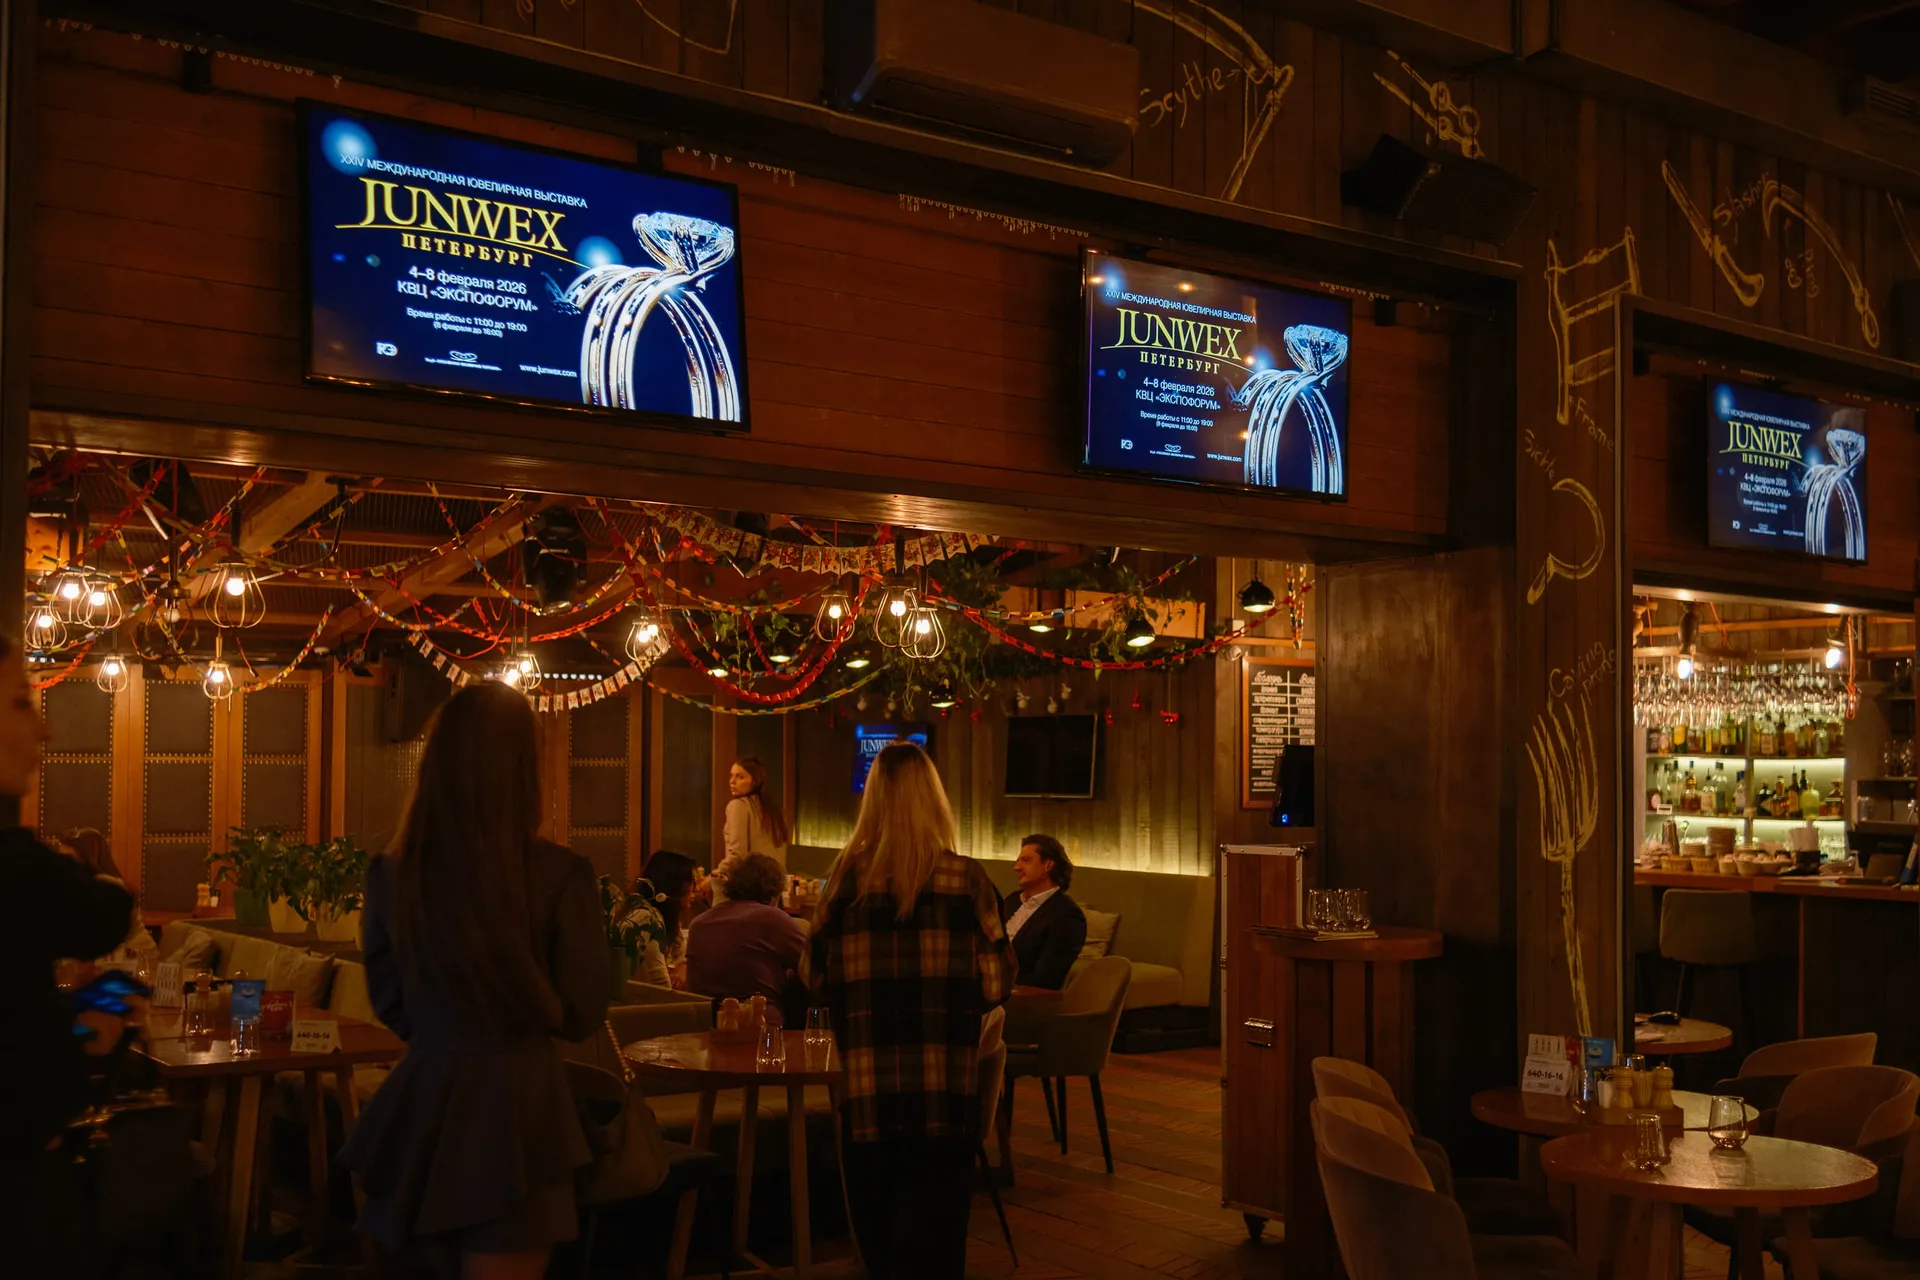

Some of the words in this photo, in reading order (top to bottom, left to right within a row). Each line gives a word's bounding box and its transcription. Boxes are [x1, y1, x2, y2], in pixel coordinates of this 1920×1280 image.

[1140, 60, 1226, 128] Scythe
[341, 154, 364, 168] XXIV
[367, 158, 466, 186] МЕЖДУНАРОДНАЯ
[467, 177, 533, 199] ЮВЕЛИРНАЯ
[534, 188, 588, 209] ВЫСТАВКА
[358, 176, 568, 252] JUNWEX
[401, 232, 534, 268] ПЕТЕРБУРГ
[397, 280, 428, 298] КВЦ
[430, 286, 538, 312] «ЭКСПОФОРУМ»
[437, 270, 494, 290] февраля
[497, 279, 527, 294] 2026
[406, 307, 434, 318] Время
[434, 312, 465, 323] работы
[473, 318, 493, 327] 11:00
[1121, 292, 1181, 310] МЕЖДУНАРОДНАЯ
[1182, 300, 1222, 317] ЮВЕЛИРНАЯ
[1223, 309, 1256, 324] ВЫСТАВКА
[1116, 308, 1242, 360] JUNWEX
[1140, 351, 1220, 374] ПЕТЕРБУРГ
[1136, 389, 1153, 402] КВЦ
[1155, 393, 1220, 410] «ЭКСПОФОРУМ»
[1160, 380, 1194, 394] февраля
[1196, 385, 1215, 396] 2026
[1575, 396, 1614, 452] Frame
[1728, 421, 1802, 458] JUNWEX
[1742, 453, 1790, 470] ПЕТЕРБУРГ
[1527, 1069, 1564, 1080] 640-16-16
